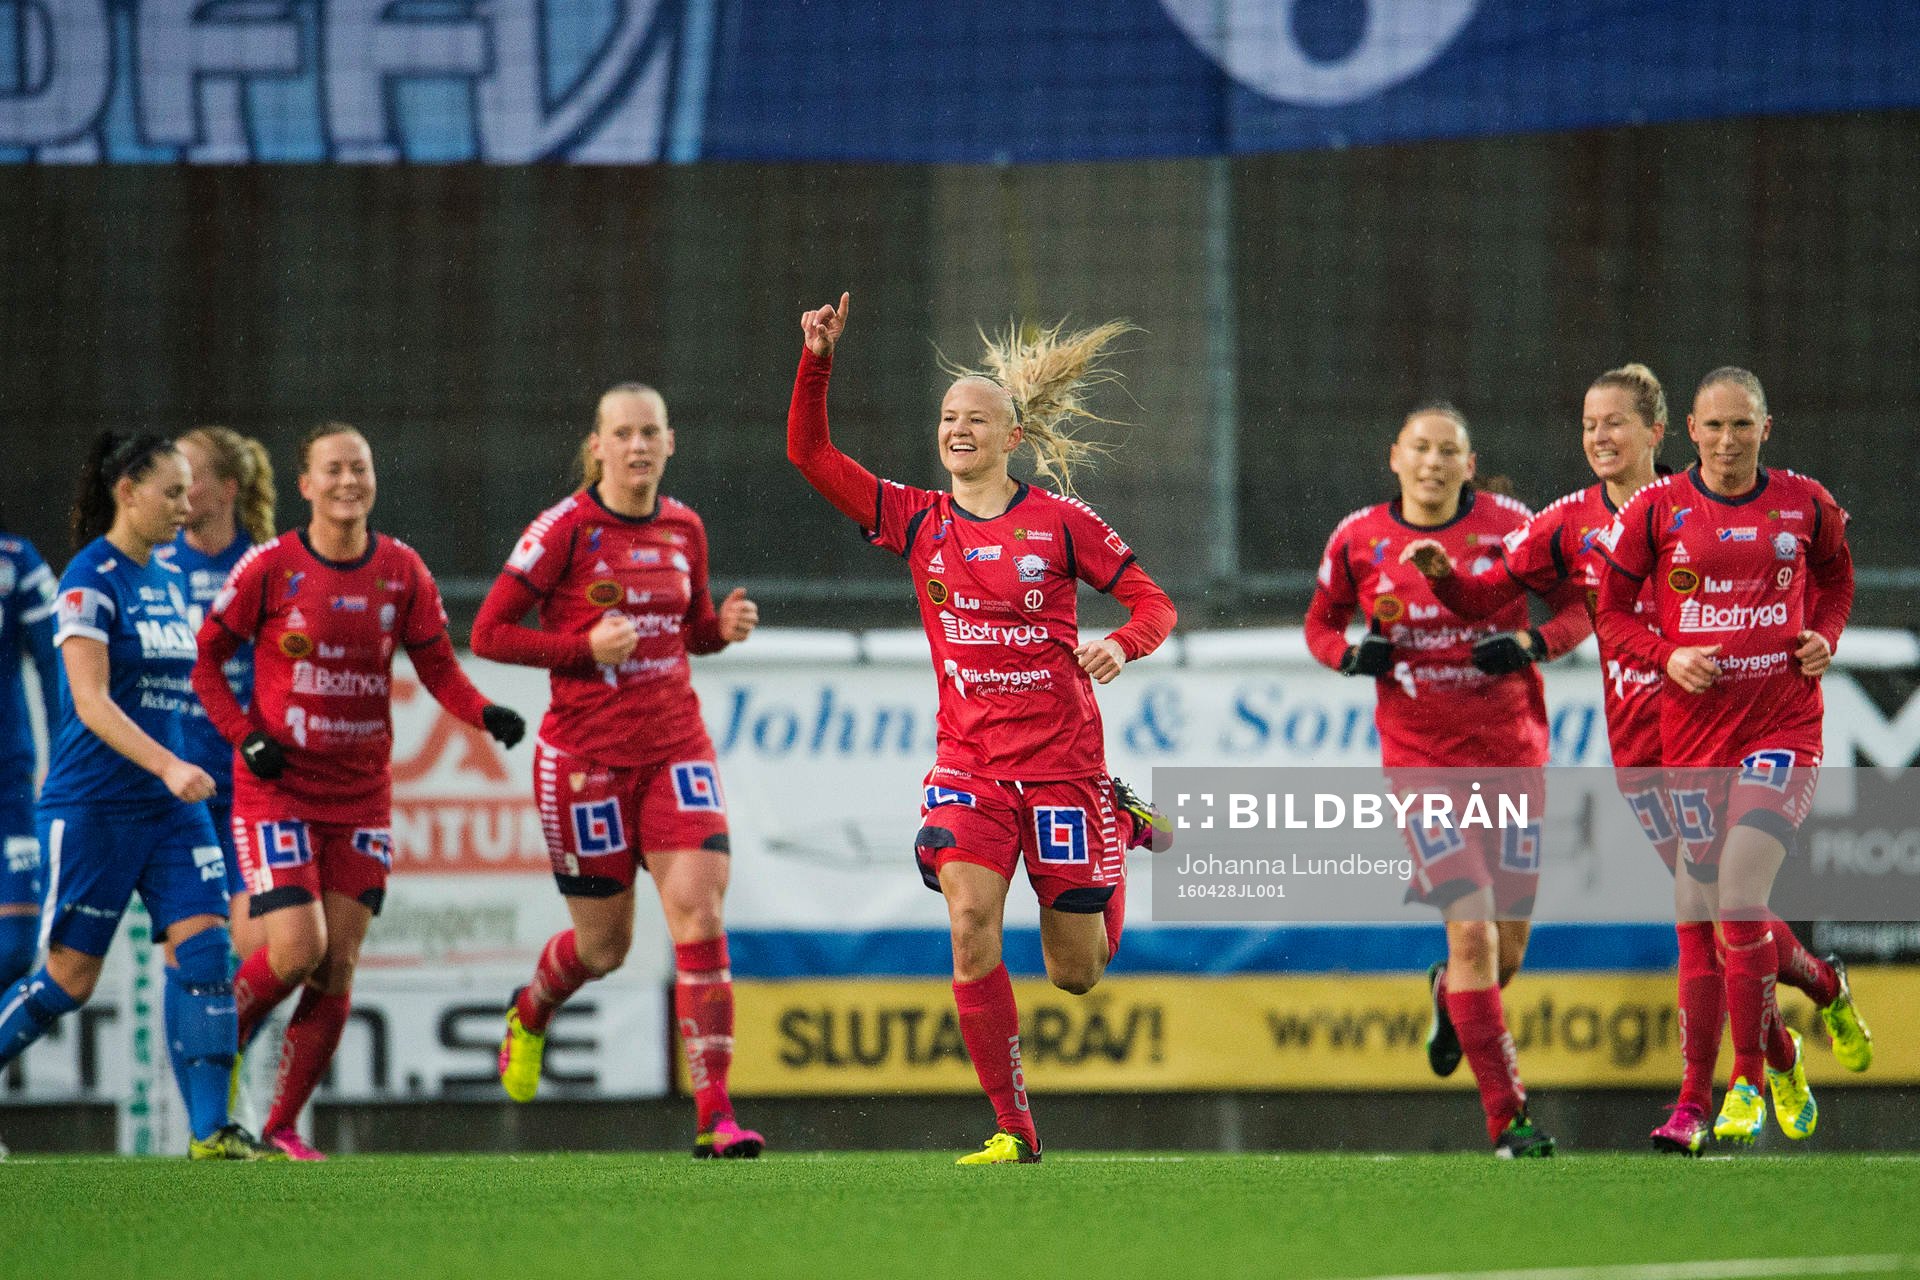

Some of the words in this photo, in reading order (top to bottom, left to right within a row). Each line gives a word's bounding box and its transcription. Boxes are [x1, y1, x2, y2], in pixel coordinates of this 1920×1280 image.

[1701, 601, 1788, 629] Botrygg
[961, 668, 1051, 685] Riksbyggen
[716, 684, 938, 757] John
[1122, 681, 1184, 757] &
